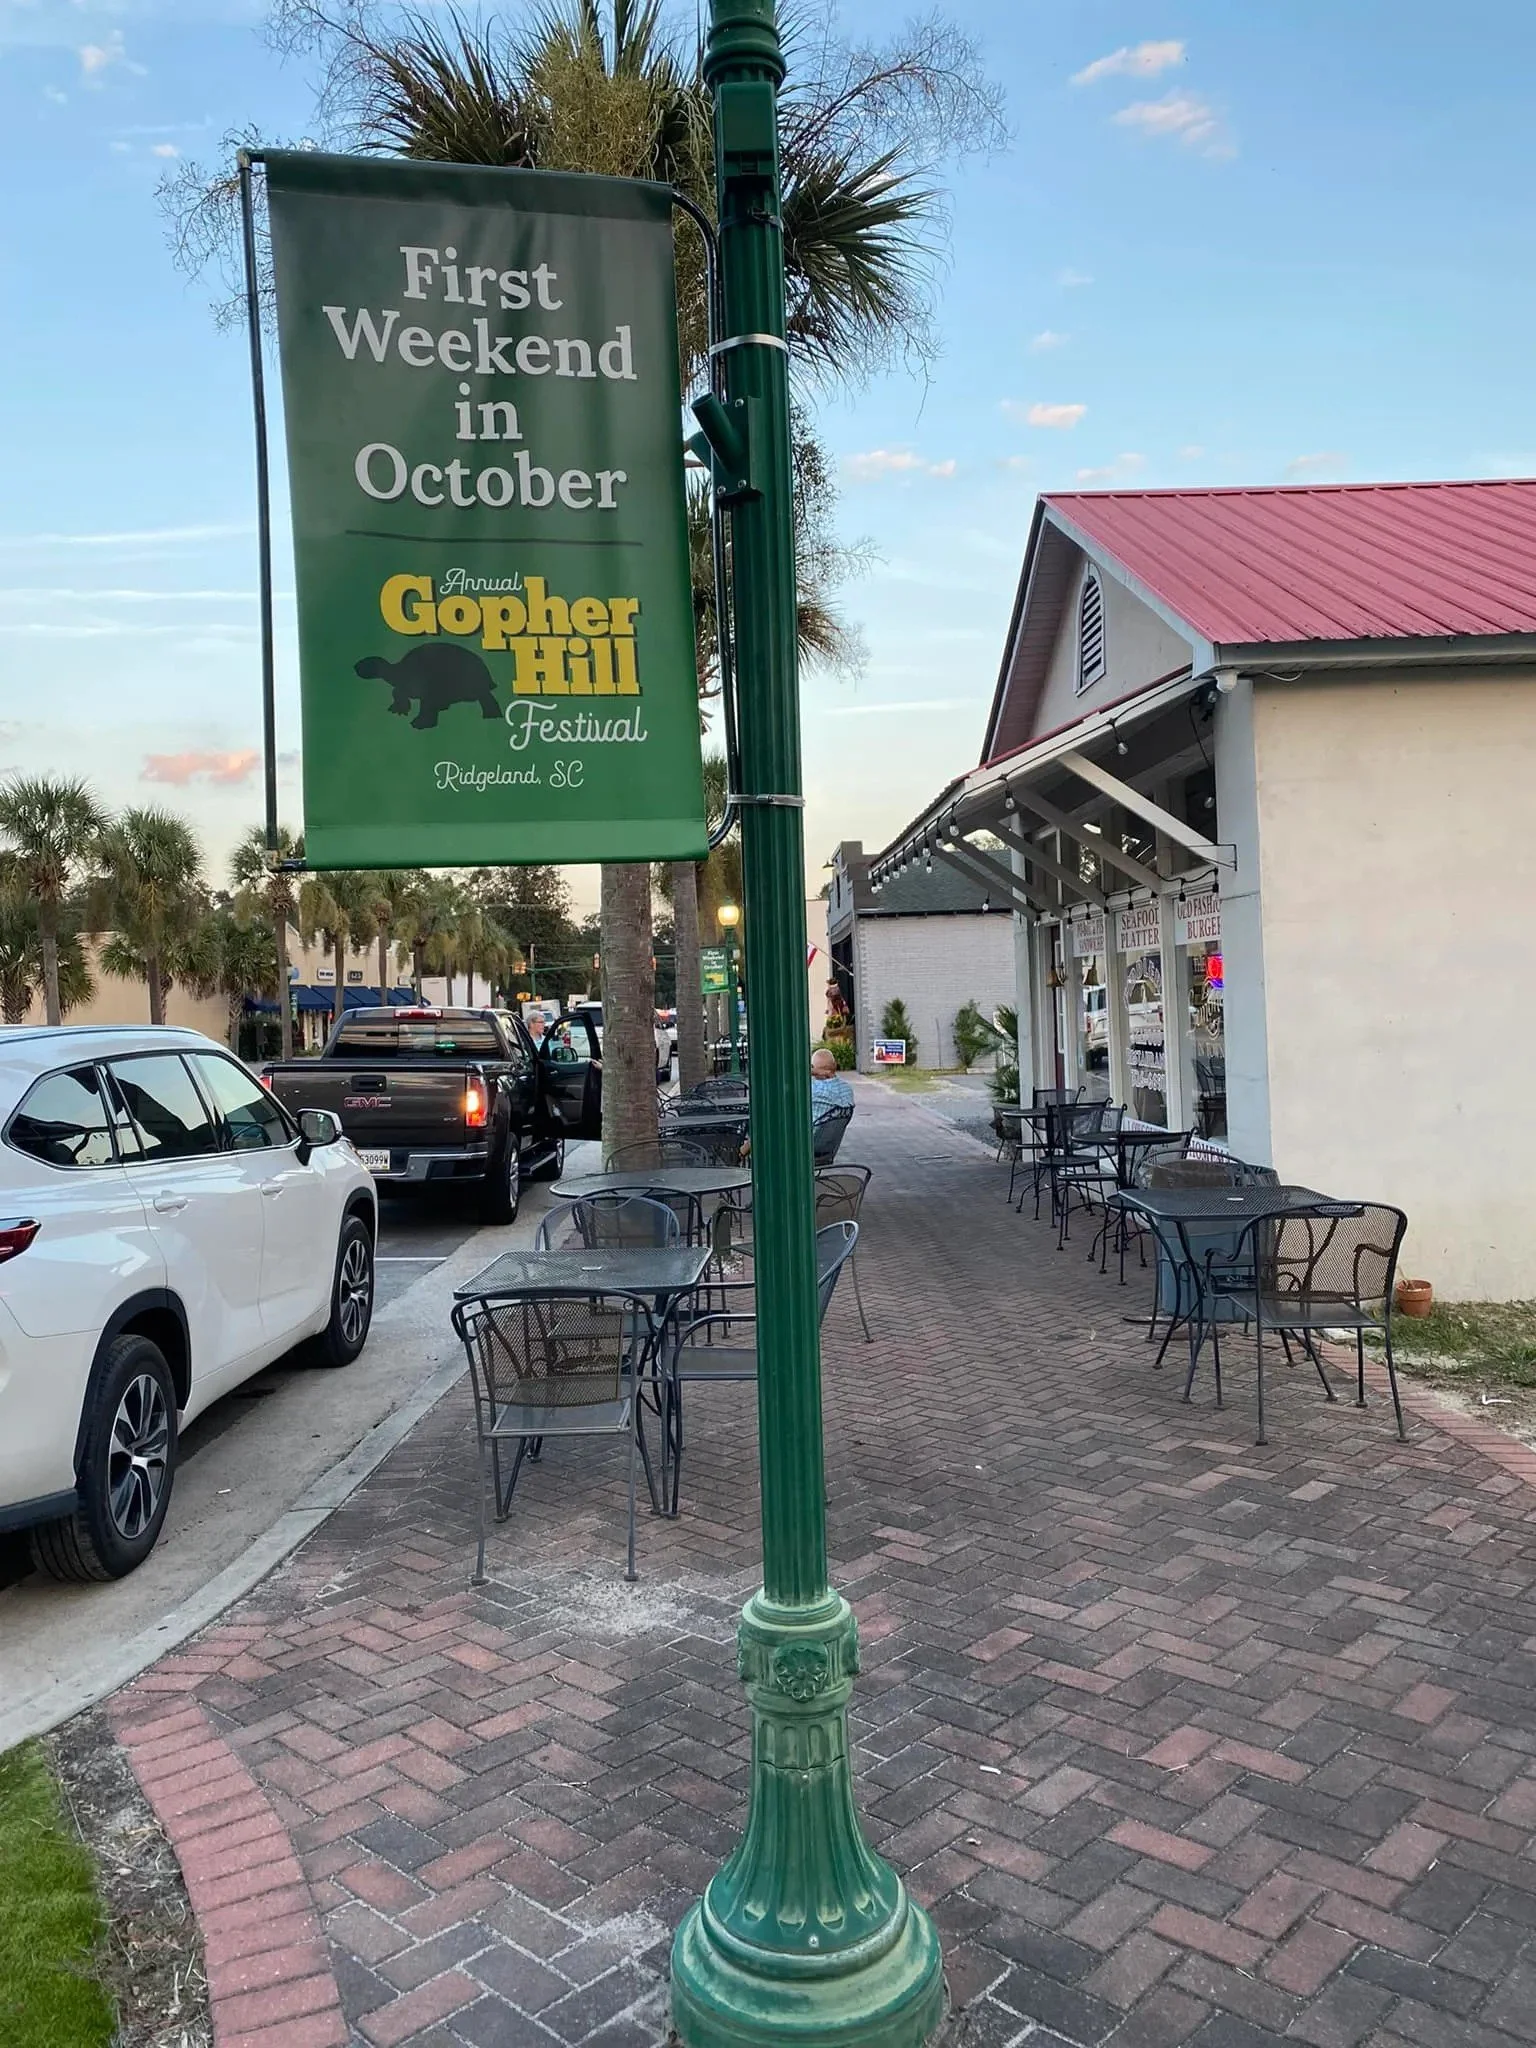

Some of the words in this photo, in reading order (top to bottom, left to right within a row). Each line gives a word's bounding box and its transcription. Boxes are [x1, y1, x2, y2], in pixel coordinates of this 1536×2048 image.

[400, 245, 563, 311] First
[322, 305, 638, 380] Weekend
[455, 382, 523, 441] in
[354, 441, 628, 509] October
[439, 567, 523, 594] Annual
[379, 573, 641, 650] Gopher
[512, 636, 642, 697] Hill
[504, 700, 648, 751] Festival
[547, 760, 585, 788] SC
[1120, 927, 1160, 949] PLATTER
[344, 1096, 392, 1108] GMC
